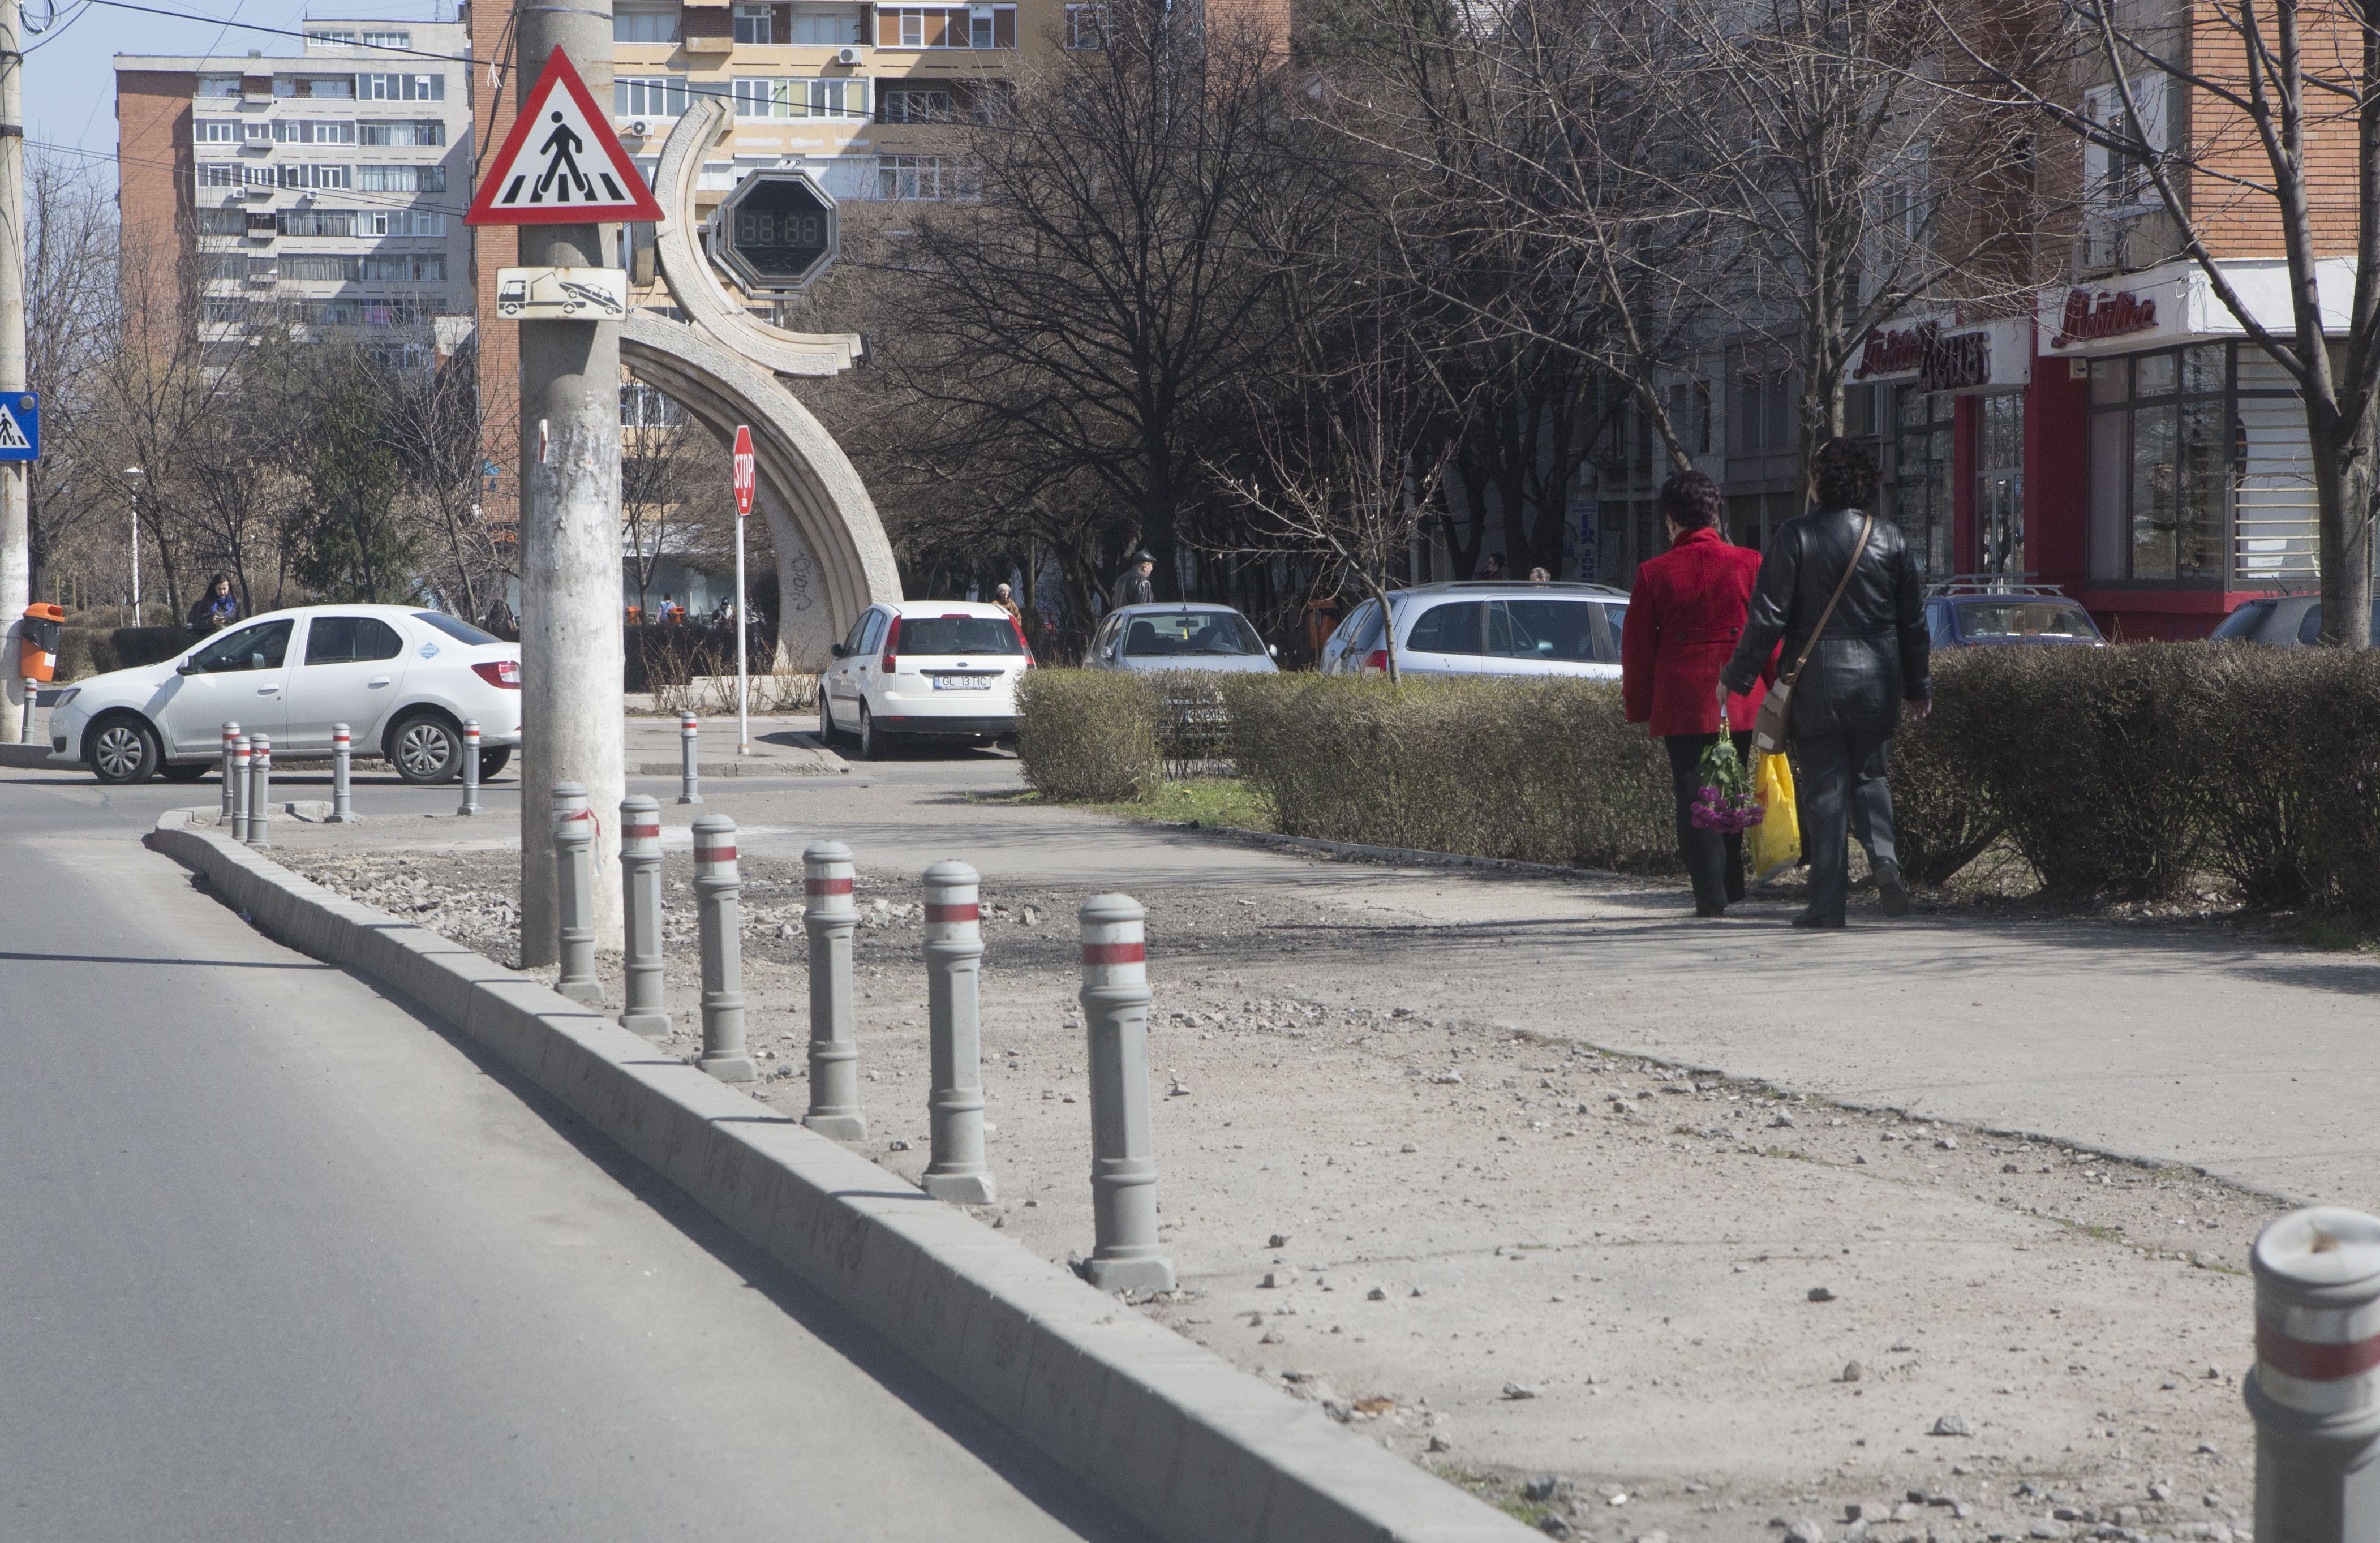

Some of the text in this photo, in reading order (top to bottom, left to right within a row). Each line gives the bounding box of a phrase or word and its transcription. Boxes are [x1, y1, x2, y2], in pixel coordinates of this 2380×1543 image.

[734, 453, 753, 489] STOP
[943, 676, 955, 686] GL
[961, 676, 969, 686] 13
